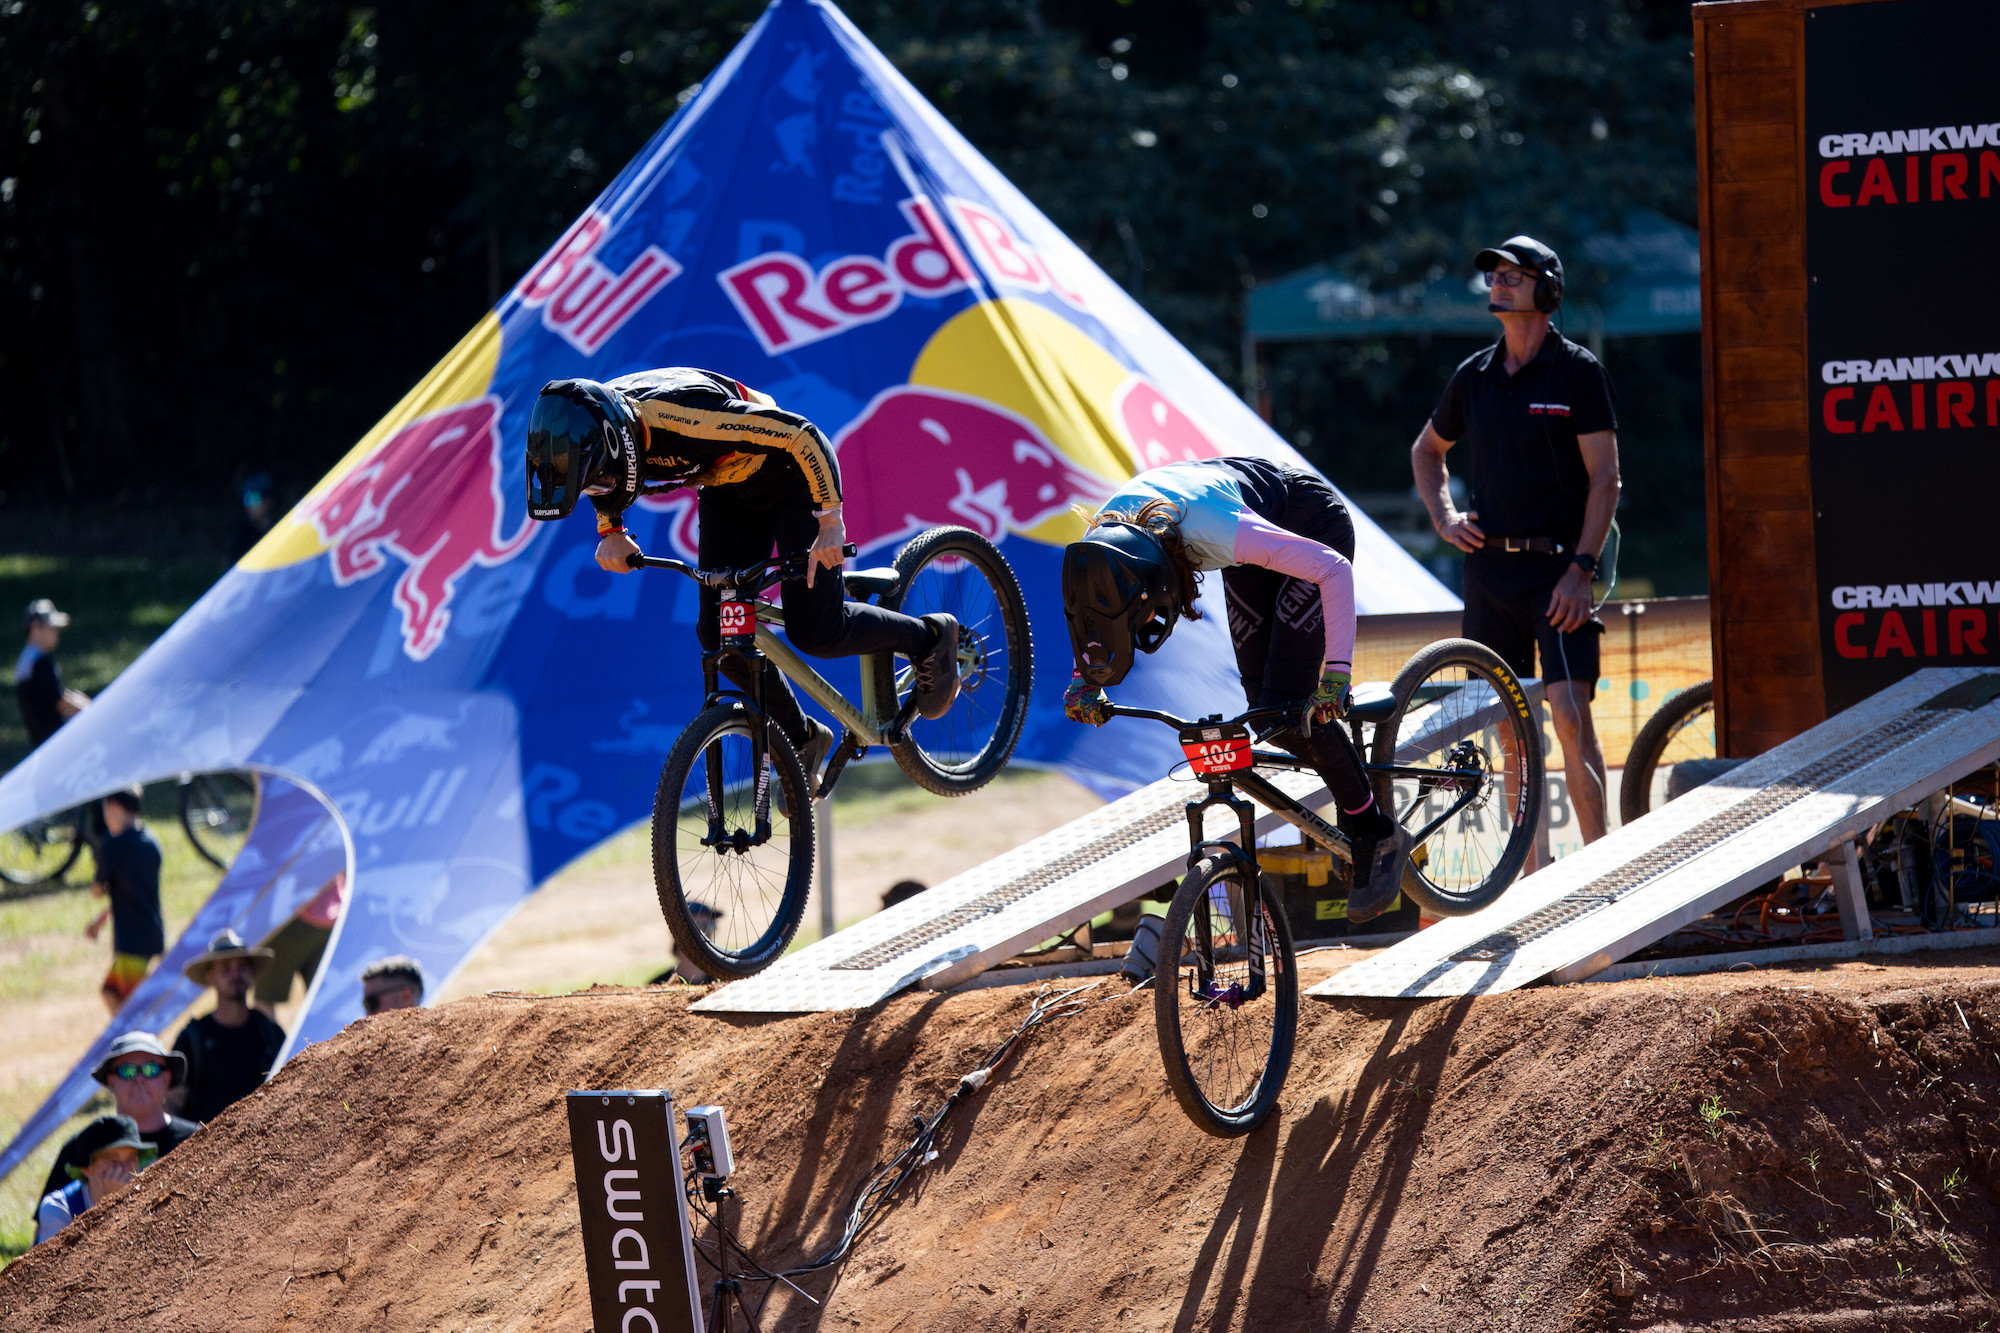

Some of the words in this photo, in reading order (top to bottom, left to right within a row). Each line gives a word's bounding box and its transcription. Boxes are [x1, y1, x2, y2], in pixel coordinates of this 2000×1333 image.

[1818, 122, 2000, 159] CRANKWO
[1819, 150, 2000, 208] CAIRN
[520, 212, 680, 353] Bull
[722, 197, 978, 352] Red
[1821, 352, 2000, 385] CRANKW
[1822, 379, 2000, 434] CAIR
[1276, 579, 1319, 624] KENN
[1831, 580, 2000, 610] CRANKW
[1834, 608, 1990, 660] CAIR
[1493, 666, 1529, 719] MAXXIS
[1200, 742, 1237, 766] 106
[596, 1118, 661, 1333] swatc
